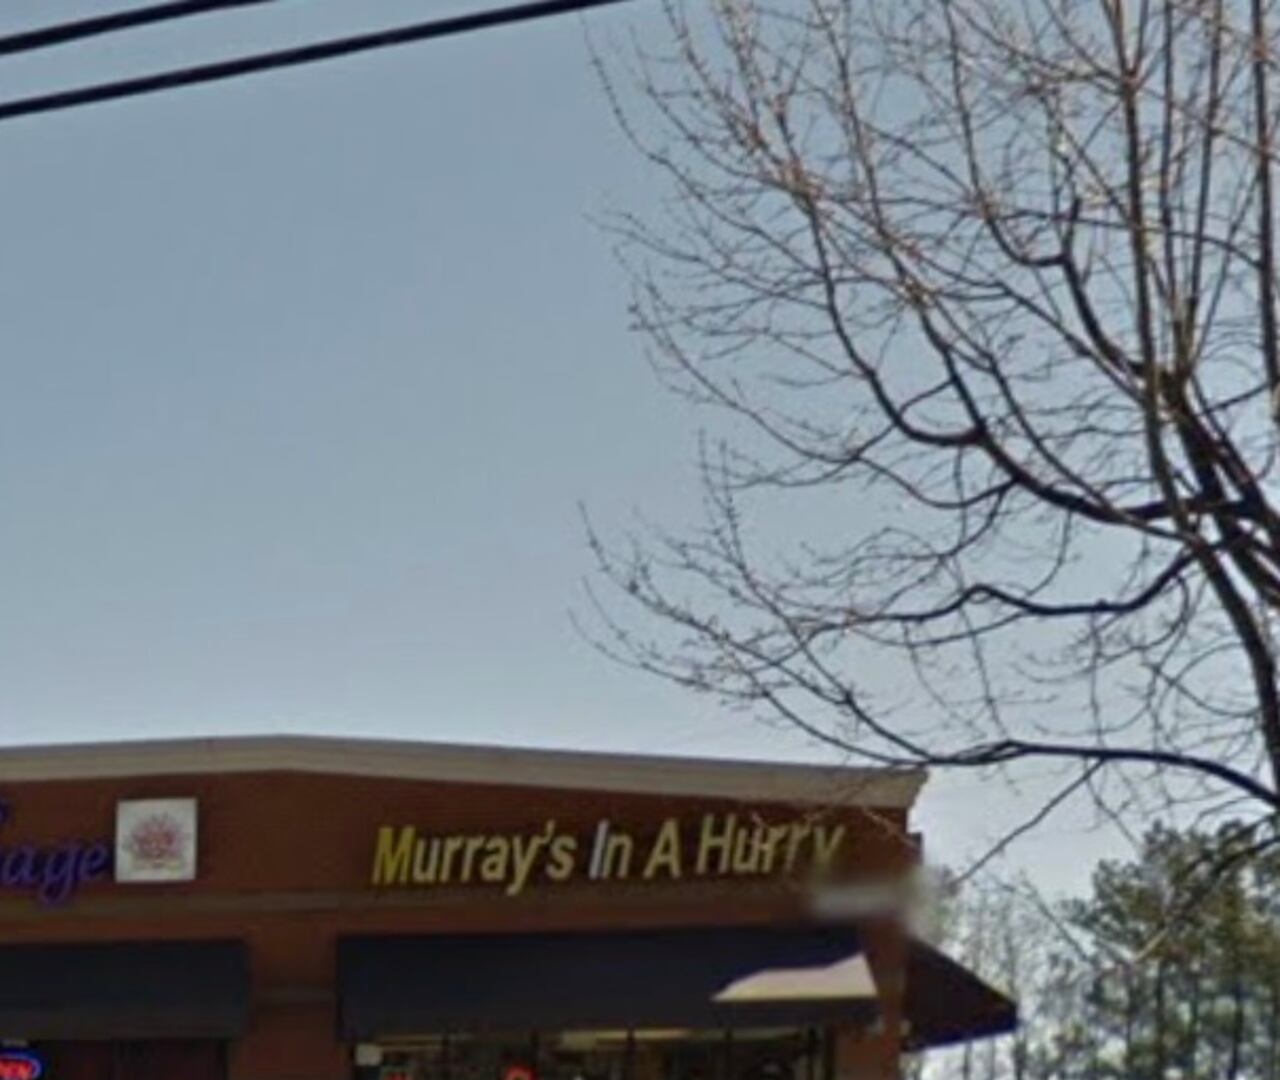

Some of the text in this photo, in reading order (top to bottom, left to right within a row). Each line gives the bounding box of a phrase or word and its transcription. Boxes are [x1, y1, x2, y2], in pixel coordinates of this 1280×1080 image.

[372, 813, 846, 896] Murray's In A Hurry
